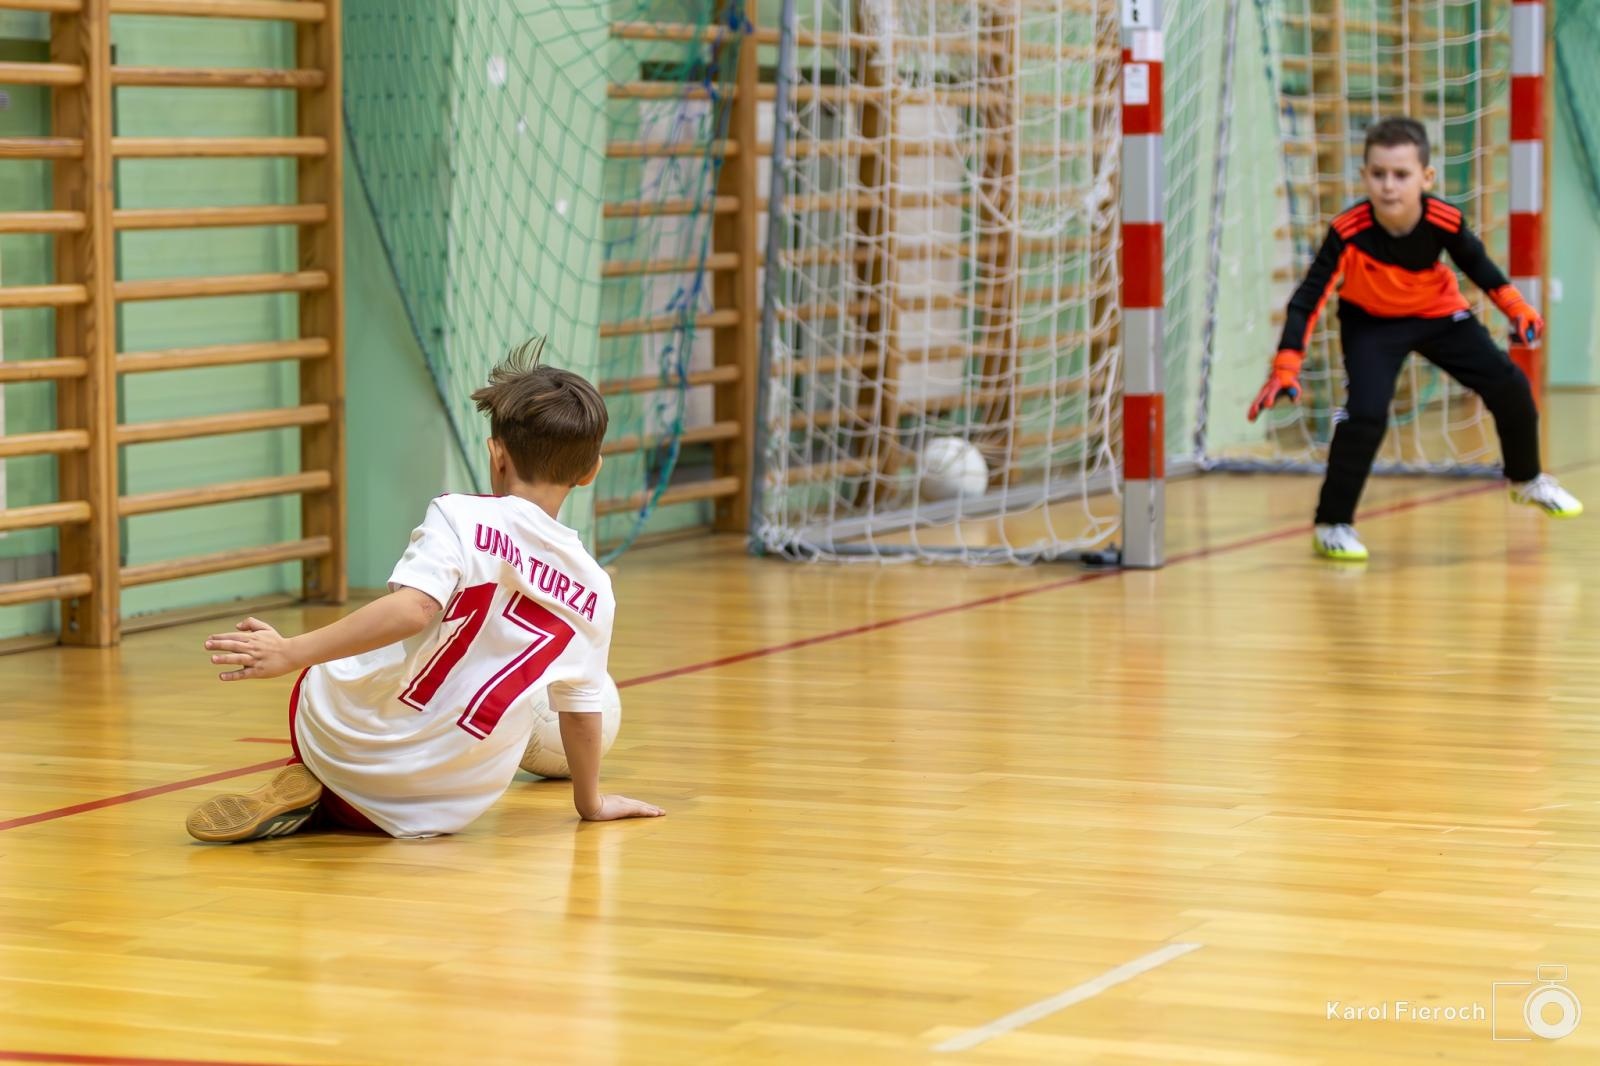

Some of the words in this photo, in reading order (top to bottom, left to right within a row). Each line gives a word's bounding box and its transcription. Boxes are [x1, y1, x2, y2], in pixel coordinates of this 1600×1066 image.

[474, 523, 523, 574] UNIA
[528, 556, 598, 622] TURZA
[398, 582, 576, 741] 77
